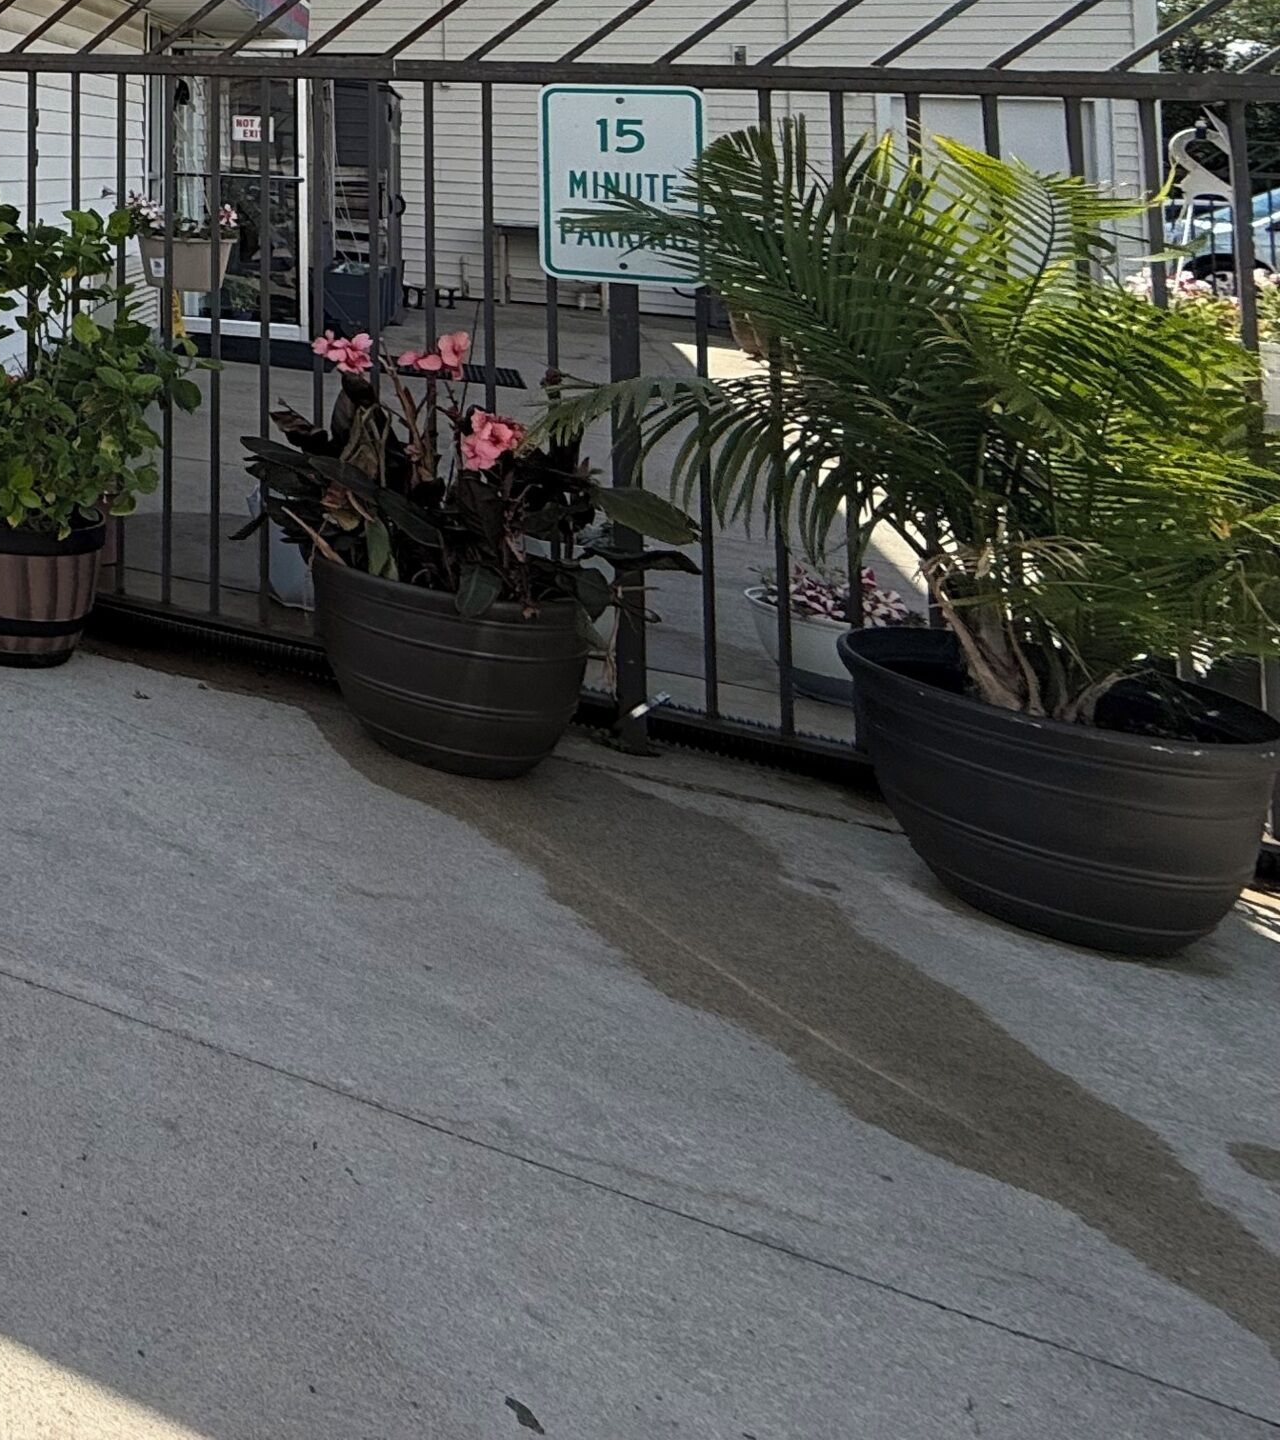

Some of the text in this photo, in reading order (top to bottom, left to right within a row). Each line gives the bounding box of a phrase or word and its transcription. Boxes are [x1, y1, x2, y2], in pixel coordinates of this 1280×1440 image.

[235, 119, 255, 128] NOT
[596, 118, 645, 153] 15
[569, 170, 678, 203] MINUTE
